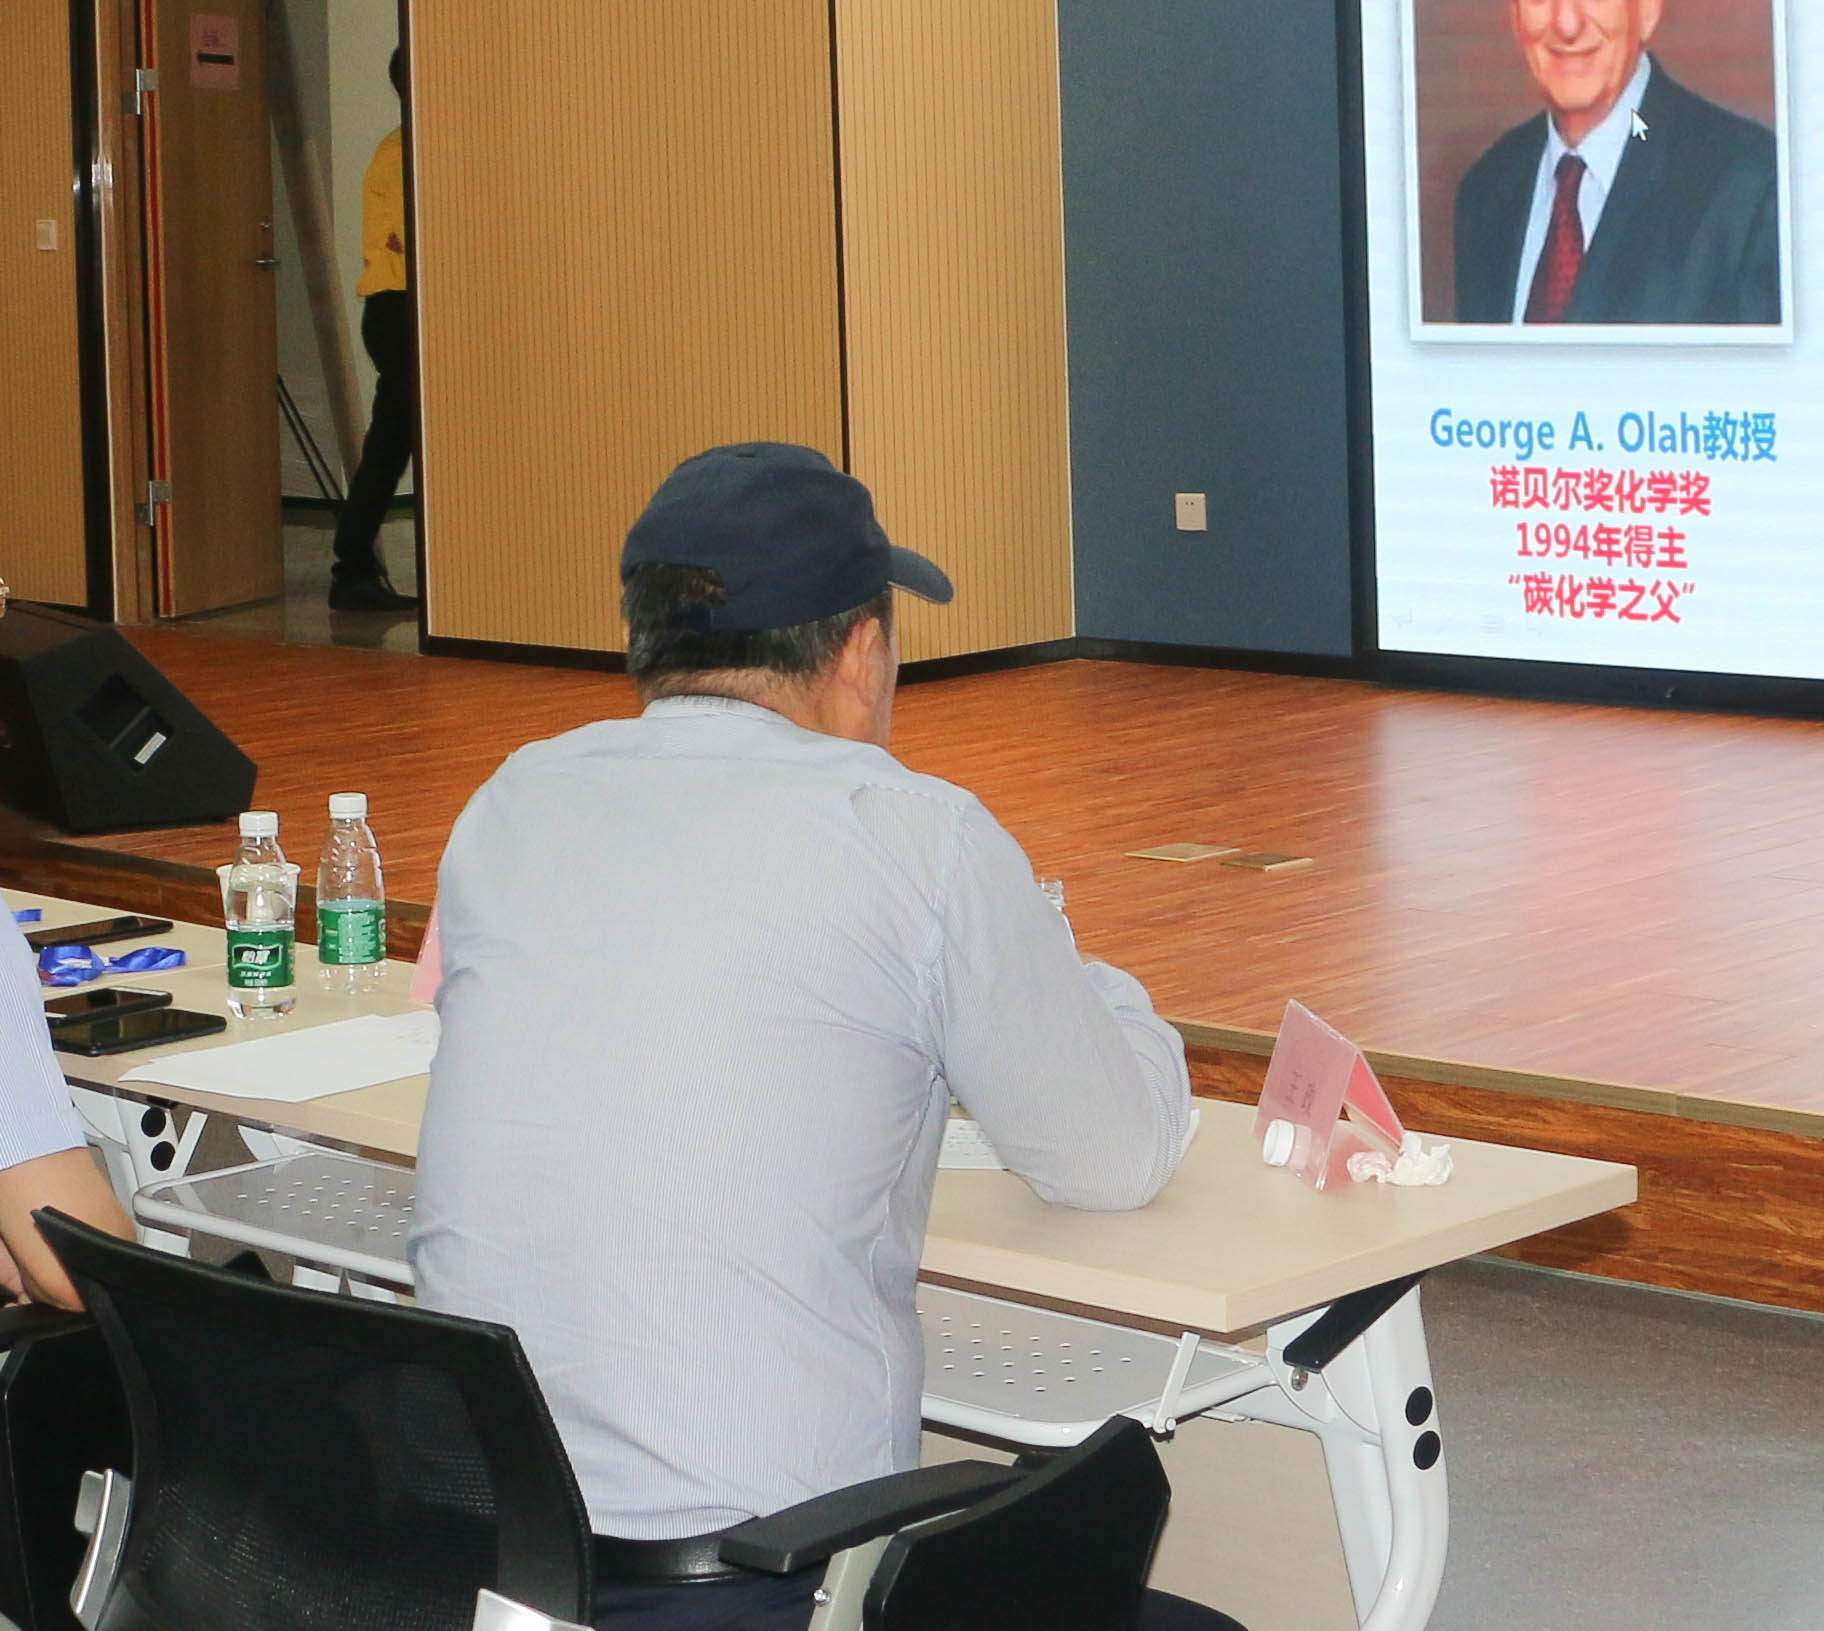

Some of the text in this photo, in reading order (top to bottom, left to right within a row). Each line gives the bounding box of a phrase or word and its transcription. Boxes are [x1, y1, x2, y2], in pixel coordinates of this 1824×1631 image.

[1429, 407, 1778, 462] George A. Olah教授
[1489, 465, 1712, 517] 诺贝尔奖化学奖
[1515, 521, 1689, 570] 1994年得主
